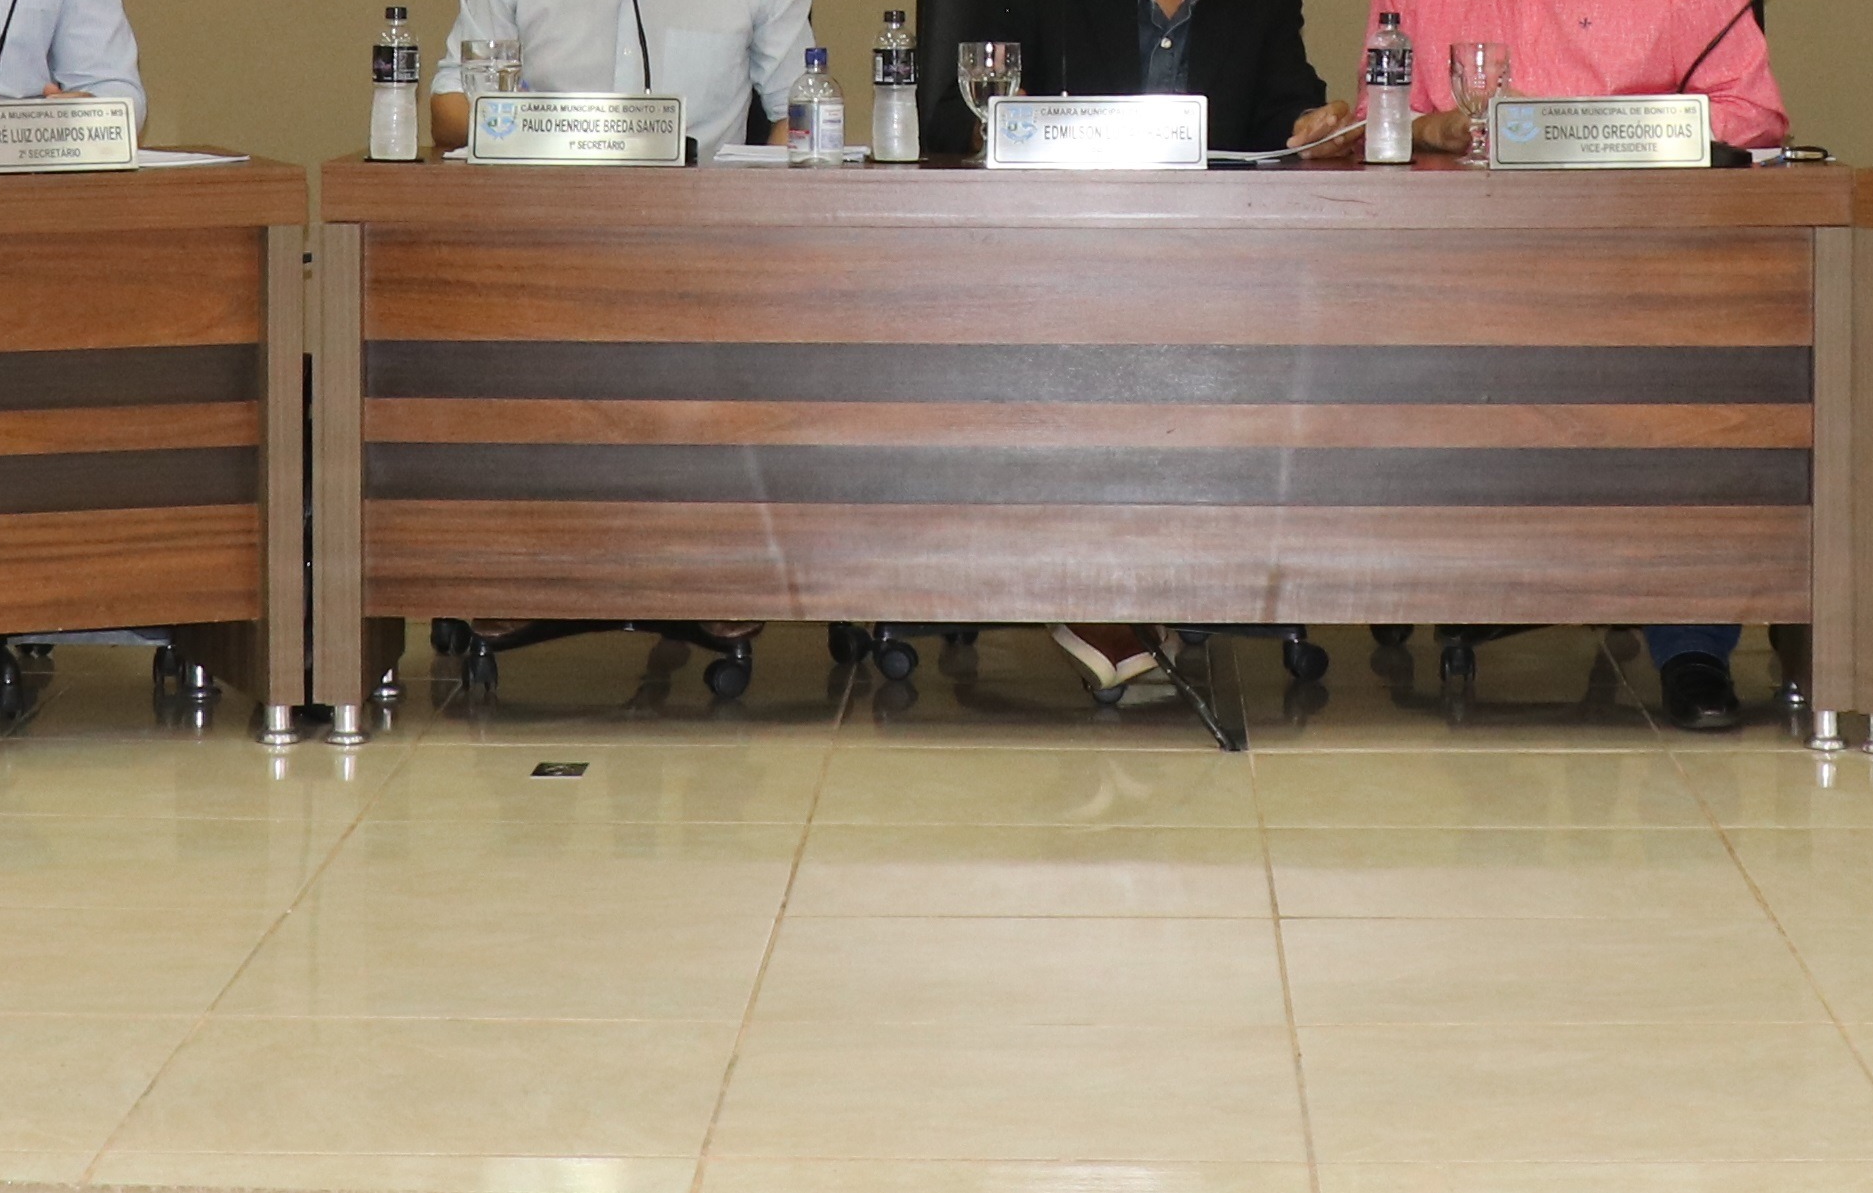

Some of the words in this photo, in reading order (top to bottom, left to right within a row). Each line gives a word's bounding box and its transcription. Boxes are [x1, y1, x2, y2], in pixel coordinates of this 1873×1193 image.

[561, 105, 605, 113] MUNICIPAL
[609, 105, 620, 113] DE
[623, 105, 655, 113] BONITO
[1581, 107, 1627, 115] MUNICIPAL
[1630, 107, 1641, 115] DE
[9, 111, 54, 120] MUNICIPAL
[522, 119, 552, 132] PAULO
[555, 119, 601, 133] HENRIQUE
[604, 119, 635, 133] BREDA
[636, 120, 673, 133] SANTOS
[1545, 125, 1598, 140] EDNALDO
[1603, 121, 1663, 139] GREGÓRIO
[1666, 124, 1692, 138] DIAS
[11, 129, 31, 143] LUIZ
[36, 127, 85, 142] OCAMPOS
[88, 126, 122, 141] XAVIER
[1044, 126, 1101, 140] EDMILSON
[578, 139, 625, 149] SECRETÁRIO
[1581, 142, 1658, 153] VICE-PRESIDENTE
[29, 148, 81, 157] SECRETÁRIO
